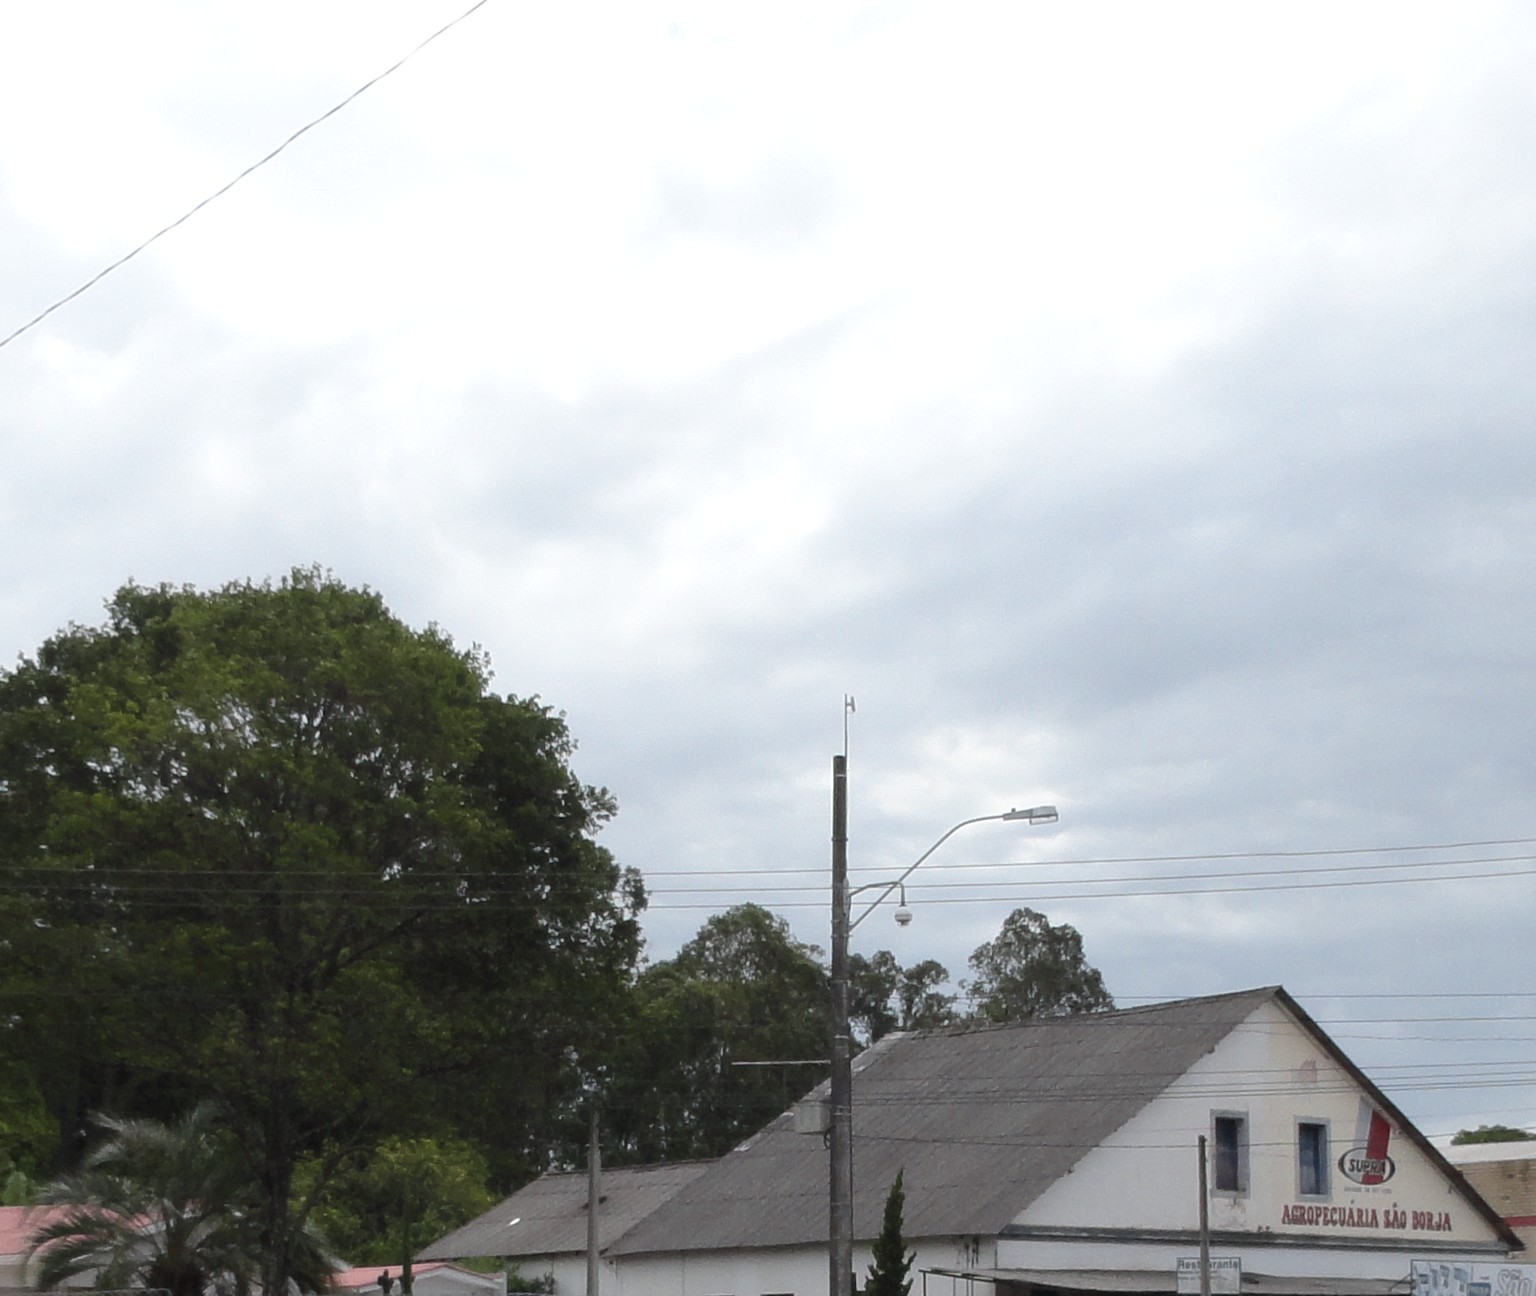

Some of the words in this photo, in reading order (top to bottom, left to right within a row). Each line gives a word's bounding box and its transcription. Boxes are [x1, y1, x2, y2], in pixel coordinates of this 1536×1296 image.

[1349, 1158, 1386, 1175] SUPRA
[1282, 1200, 1379, 1229] AGROPECUÁRIA
[1384, 1202, 1407, 1231] SÃO
[1412, 1210, 1452, 1232] BORJA
[1178, 1260, 1238, 1269] Restrante
